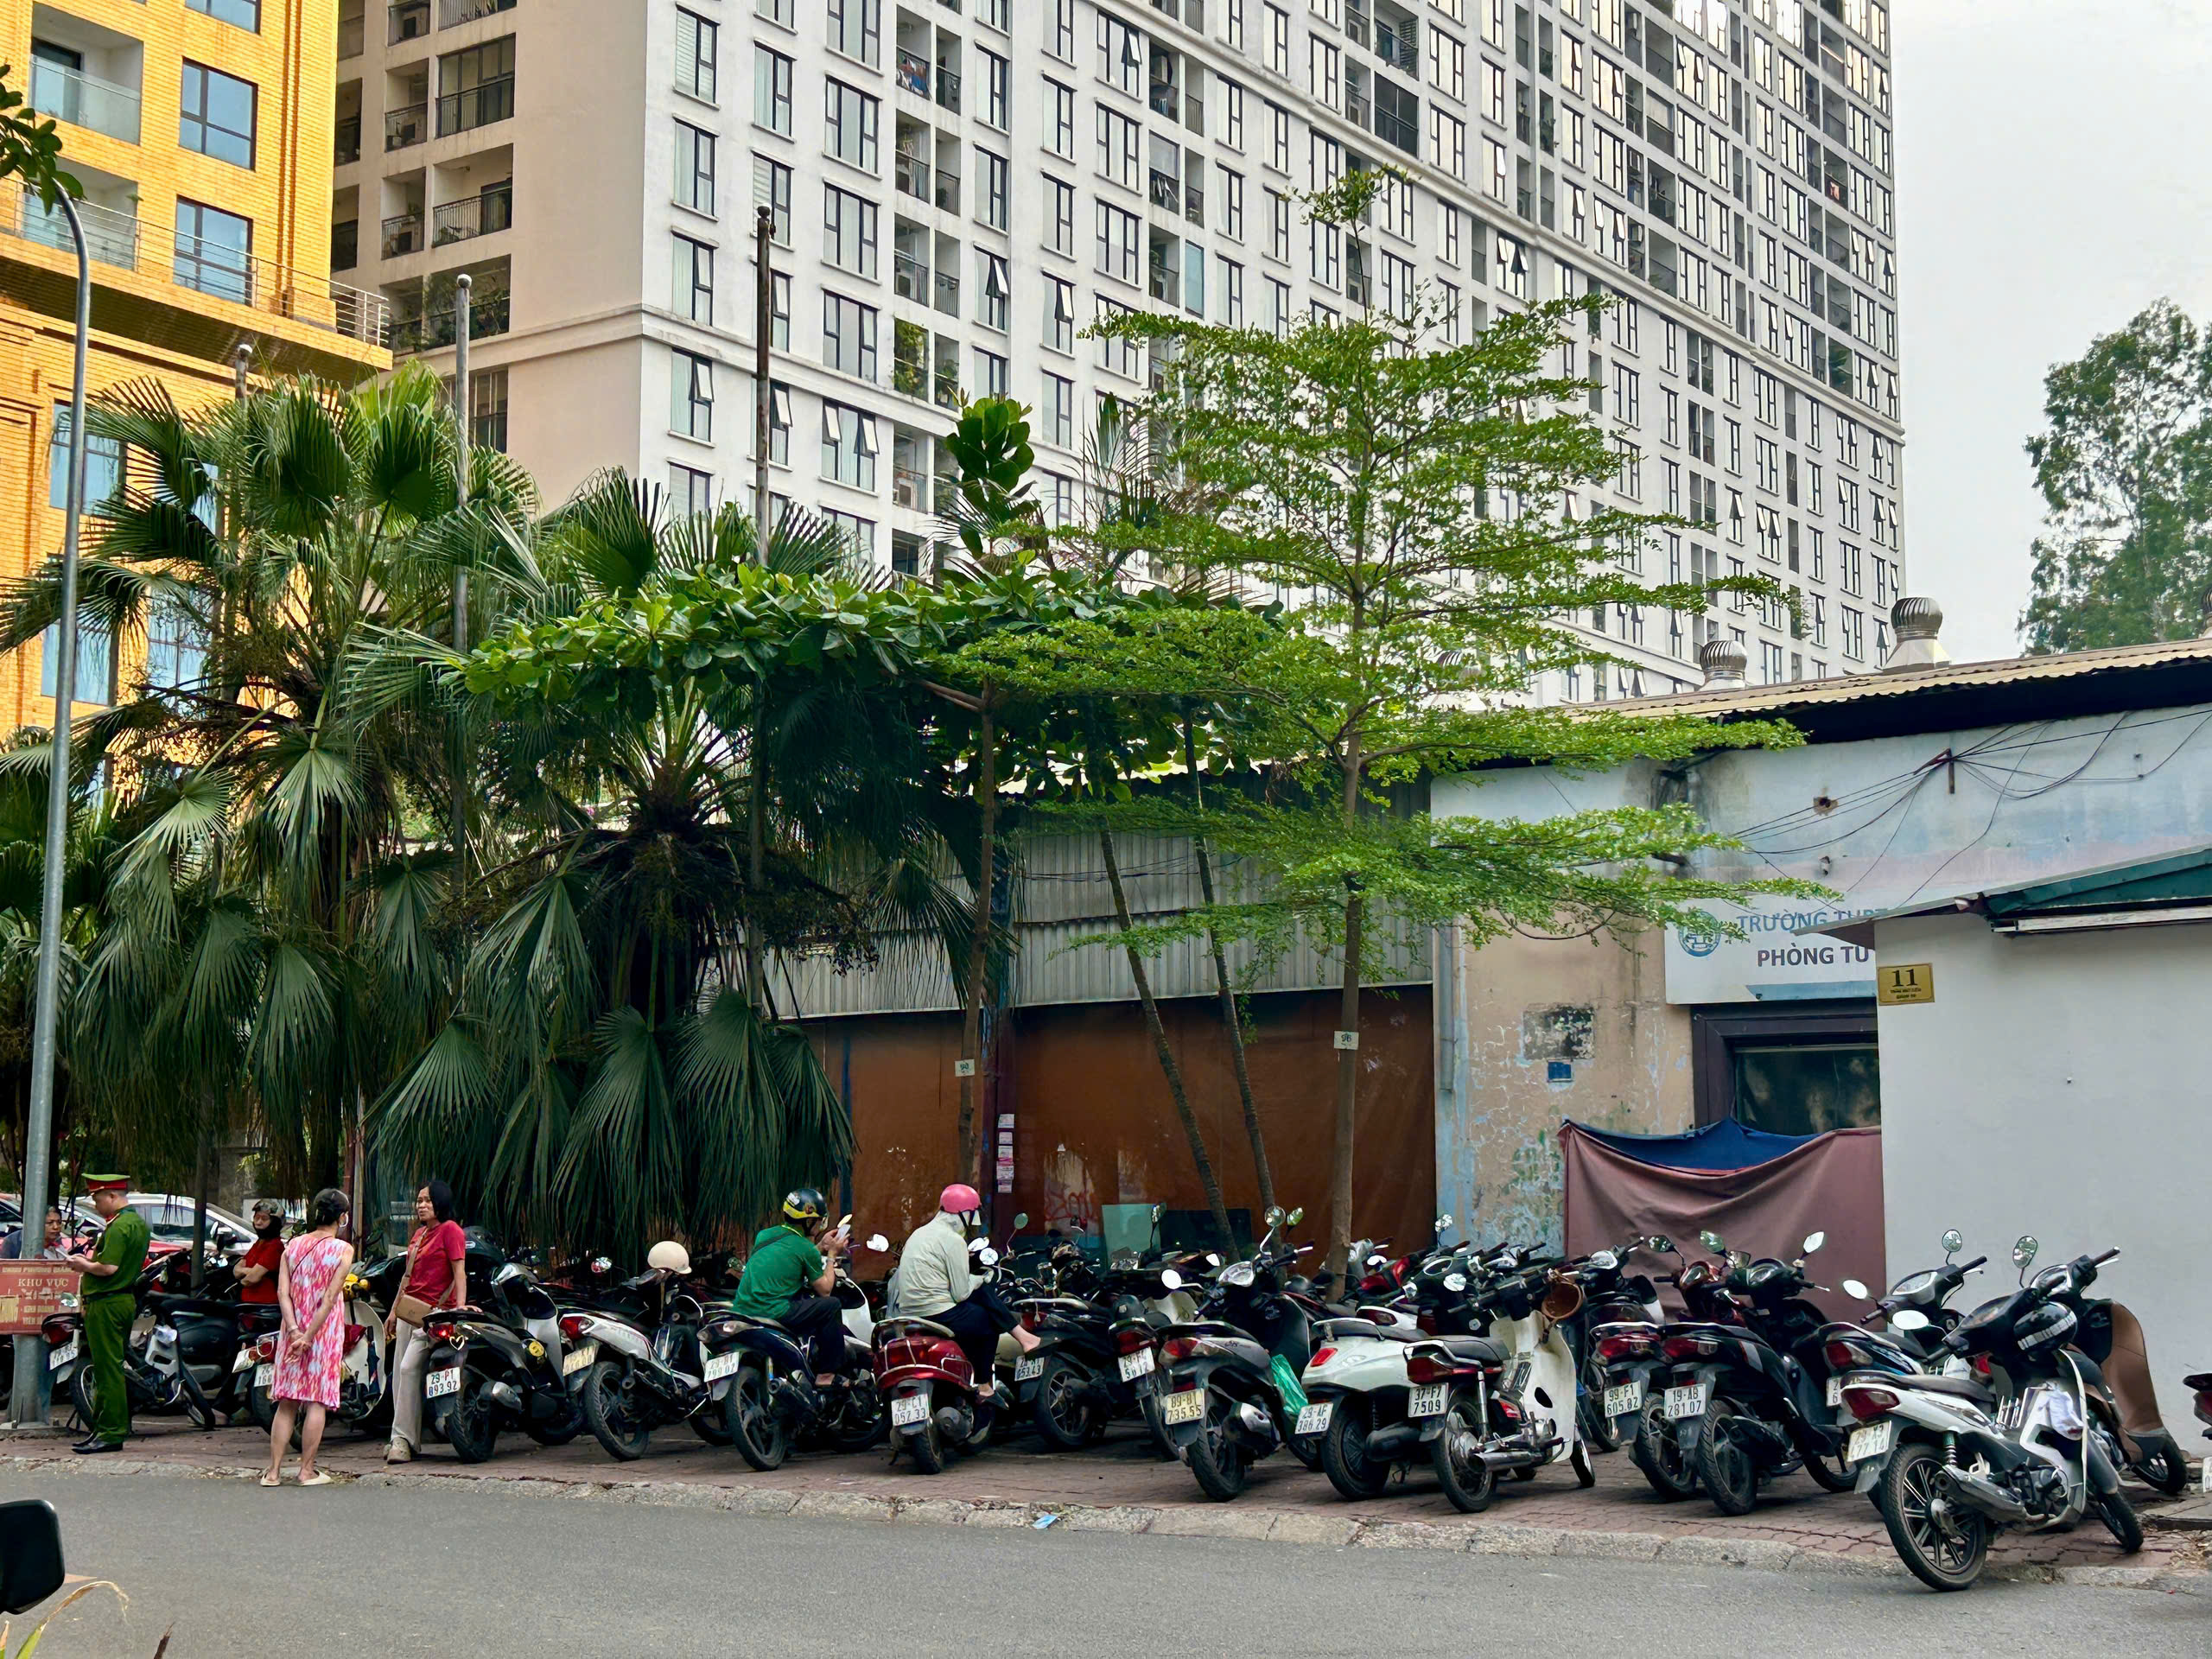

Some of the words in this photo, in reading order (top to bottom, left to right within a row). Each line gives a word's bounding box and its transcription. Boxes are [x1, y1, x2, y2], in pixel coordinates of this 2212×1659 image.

[1758, 943, 1834, 967] PHÒNG
[1891, 969, 1918, 987] 11
[18, 1278, 42, 1287] KHU
[1414, 1399, 1441, 1415] 7509
